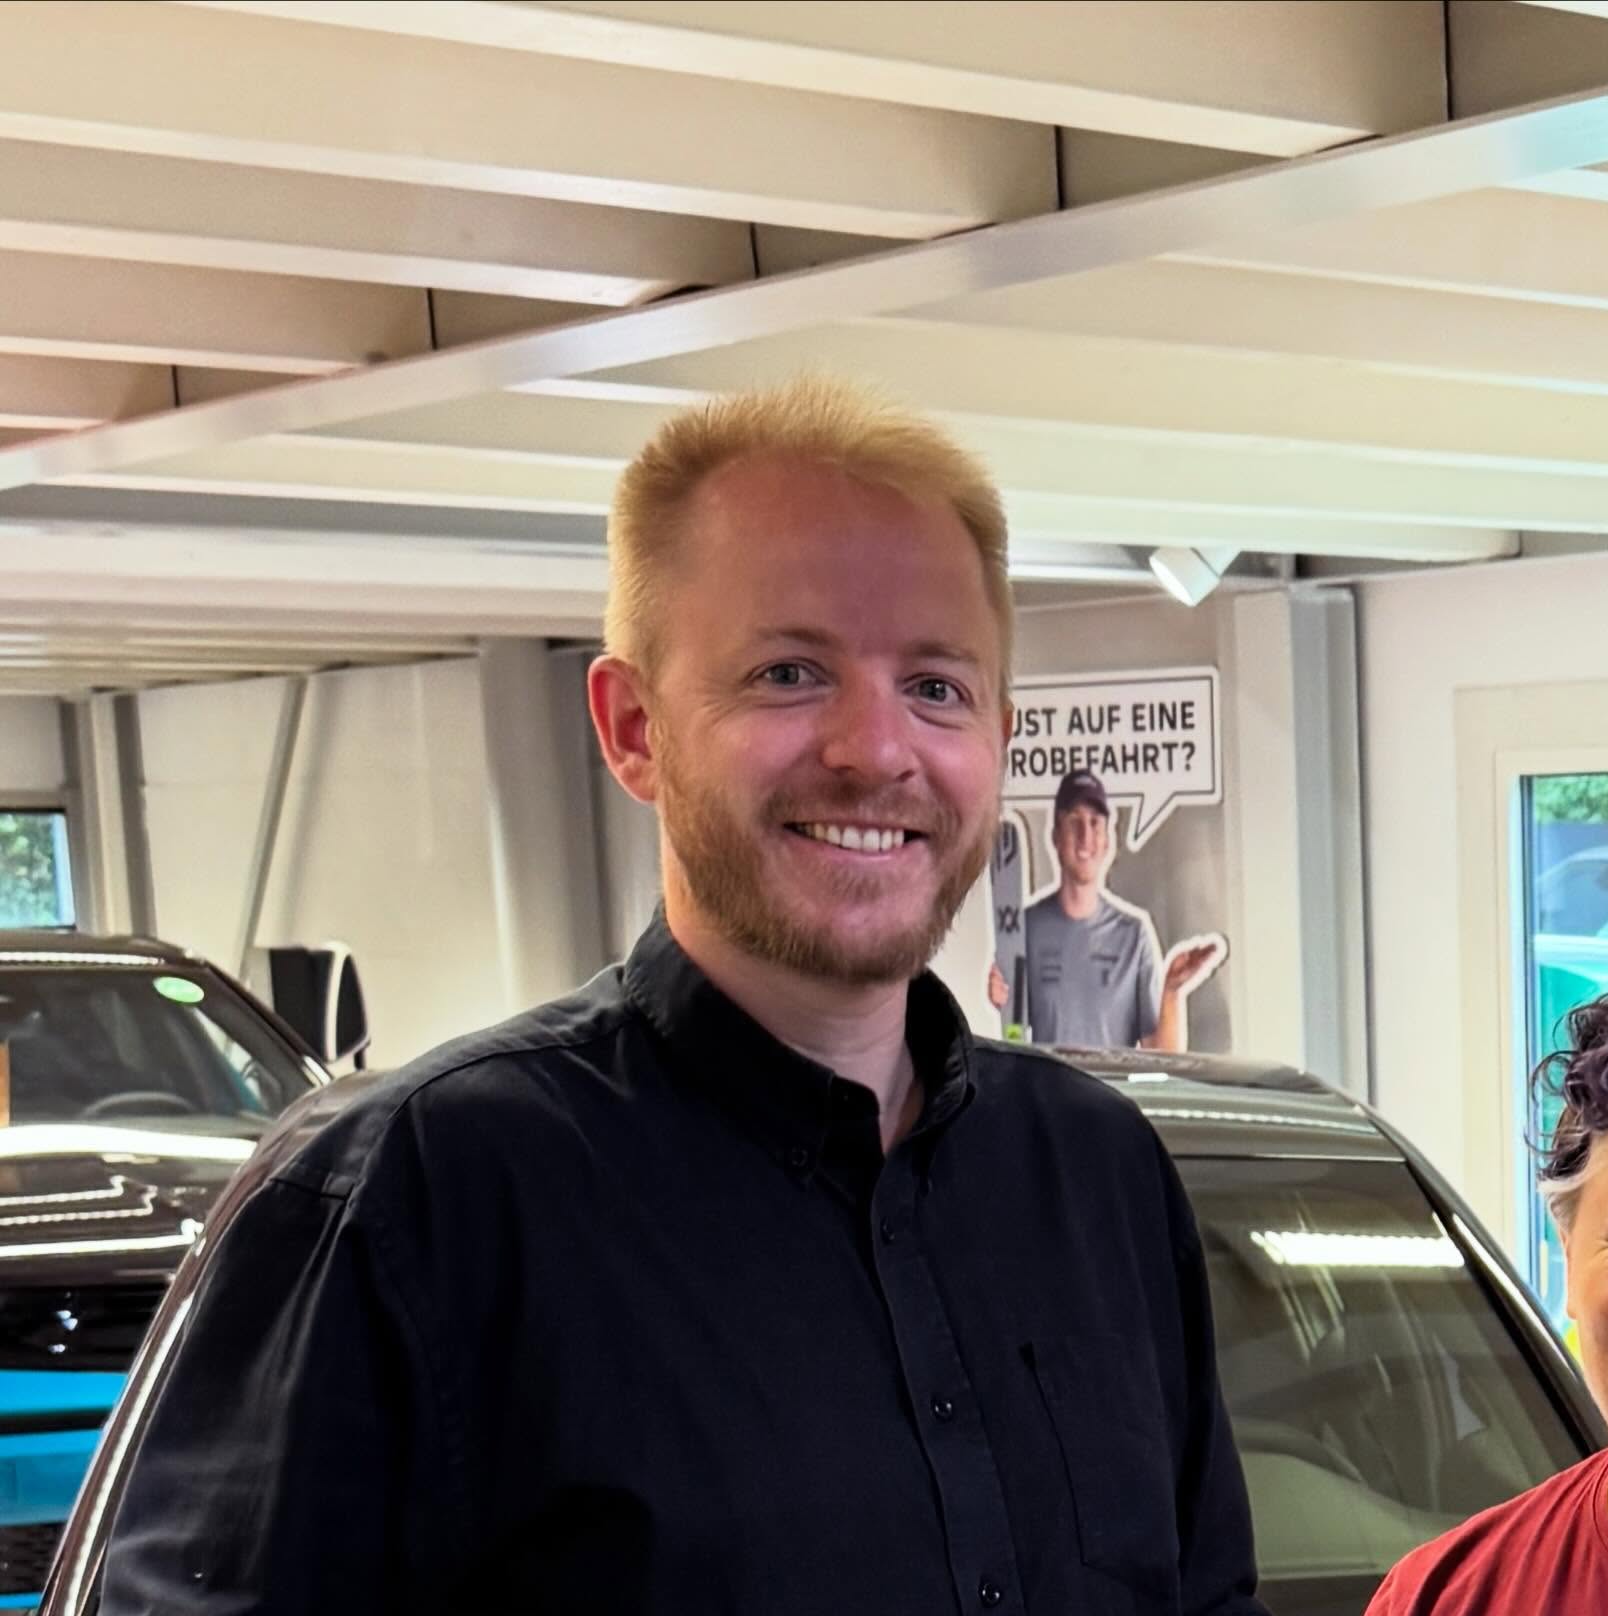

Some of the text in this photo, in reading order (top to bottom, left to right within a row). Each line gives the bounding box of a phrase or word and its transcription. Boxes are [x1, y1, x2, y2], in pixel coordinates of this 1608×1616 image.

[1013, 701, 1196, 737] UST AUF EINE
[1011, 741, 1196, 777] ROBEFAHRT?
